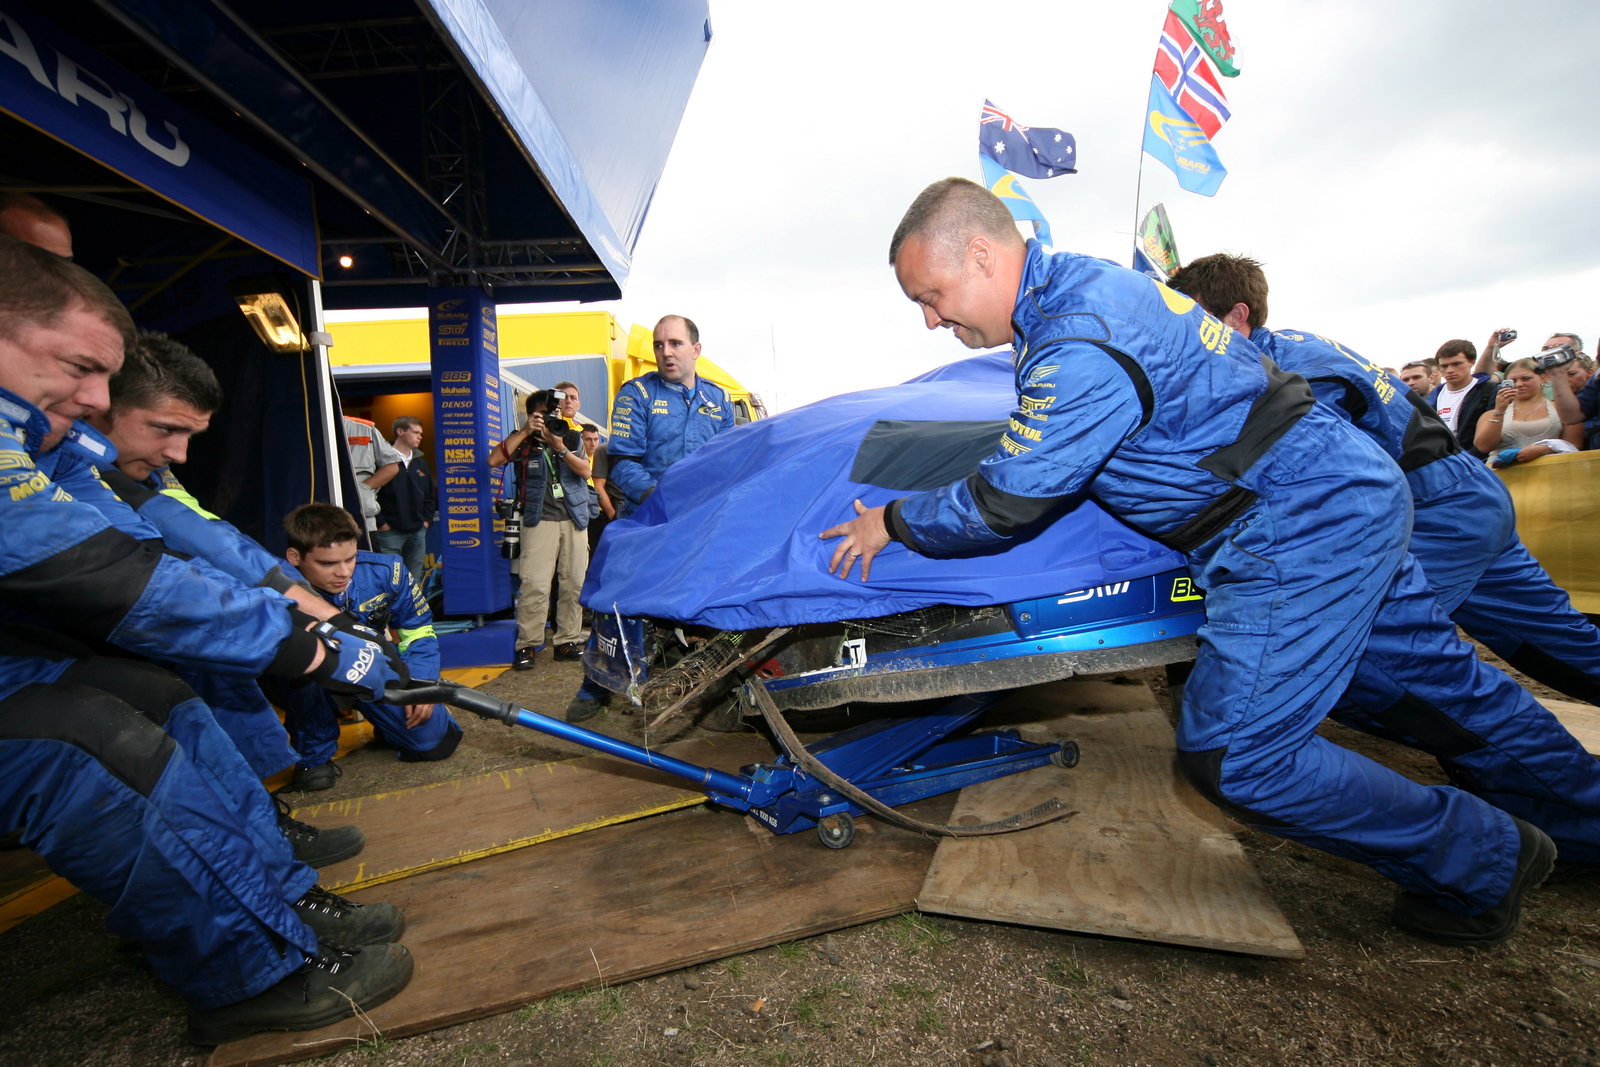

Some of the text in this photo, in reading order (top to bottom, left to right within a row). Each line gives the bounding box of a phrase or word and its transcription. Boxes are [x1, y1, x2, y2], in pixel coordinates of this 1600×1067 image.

[0, 11, 190, 167] ARU
[438, 338, 470, 346] PIRELLI
[1215, 325, 1234, 354] WOR
[441, 372, 471, 382] BBS
[441, 387, 471, 395] bluhalo
[444, 438, 475, 446] MOTUL
[444, 449, 476, 459] NSK
[445, 477, 477, 485] PIAA
[448, 506, 479, 514] sparco
[759, 810, 769, 822] 1000
[769, 816, 778, 828] KGS
